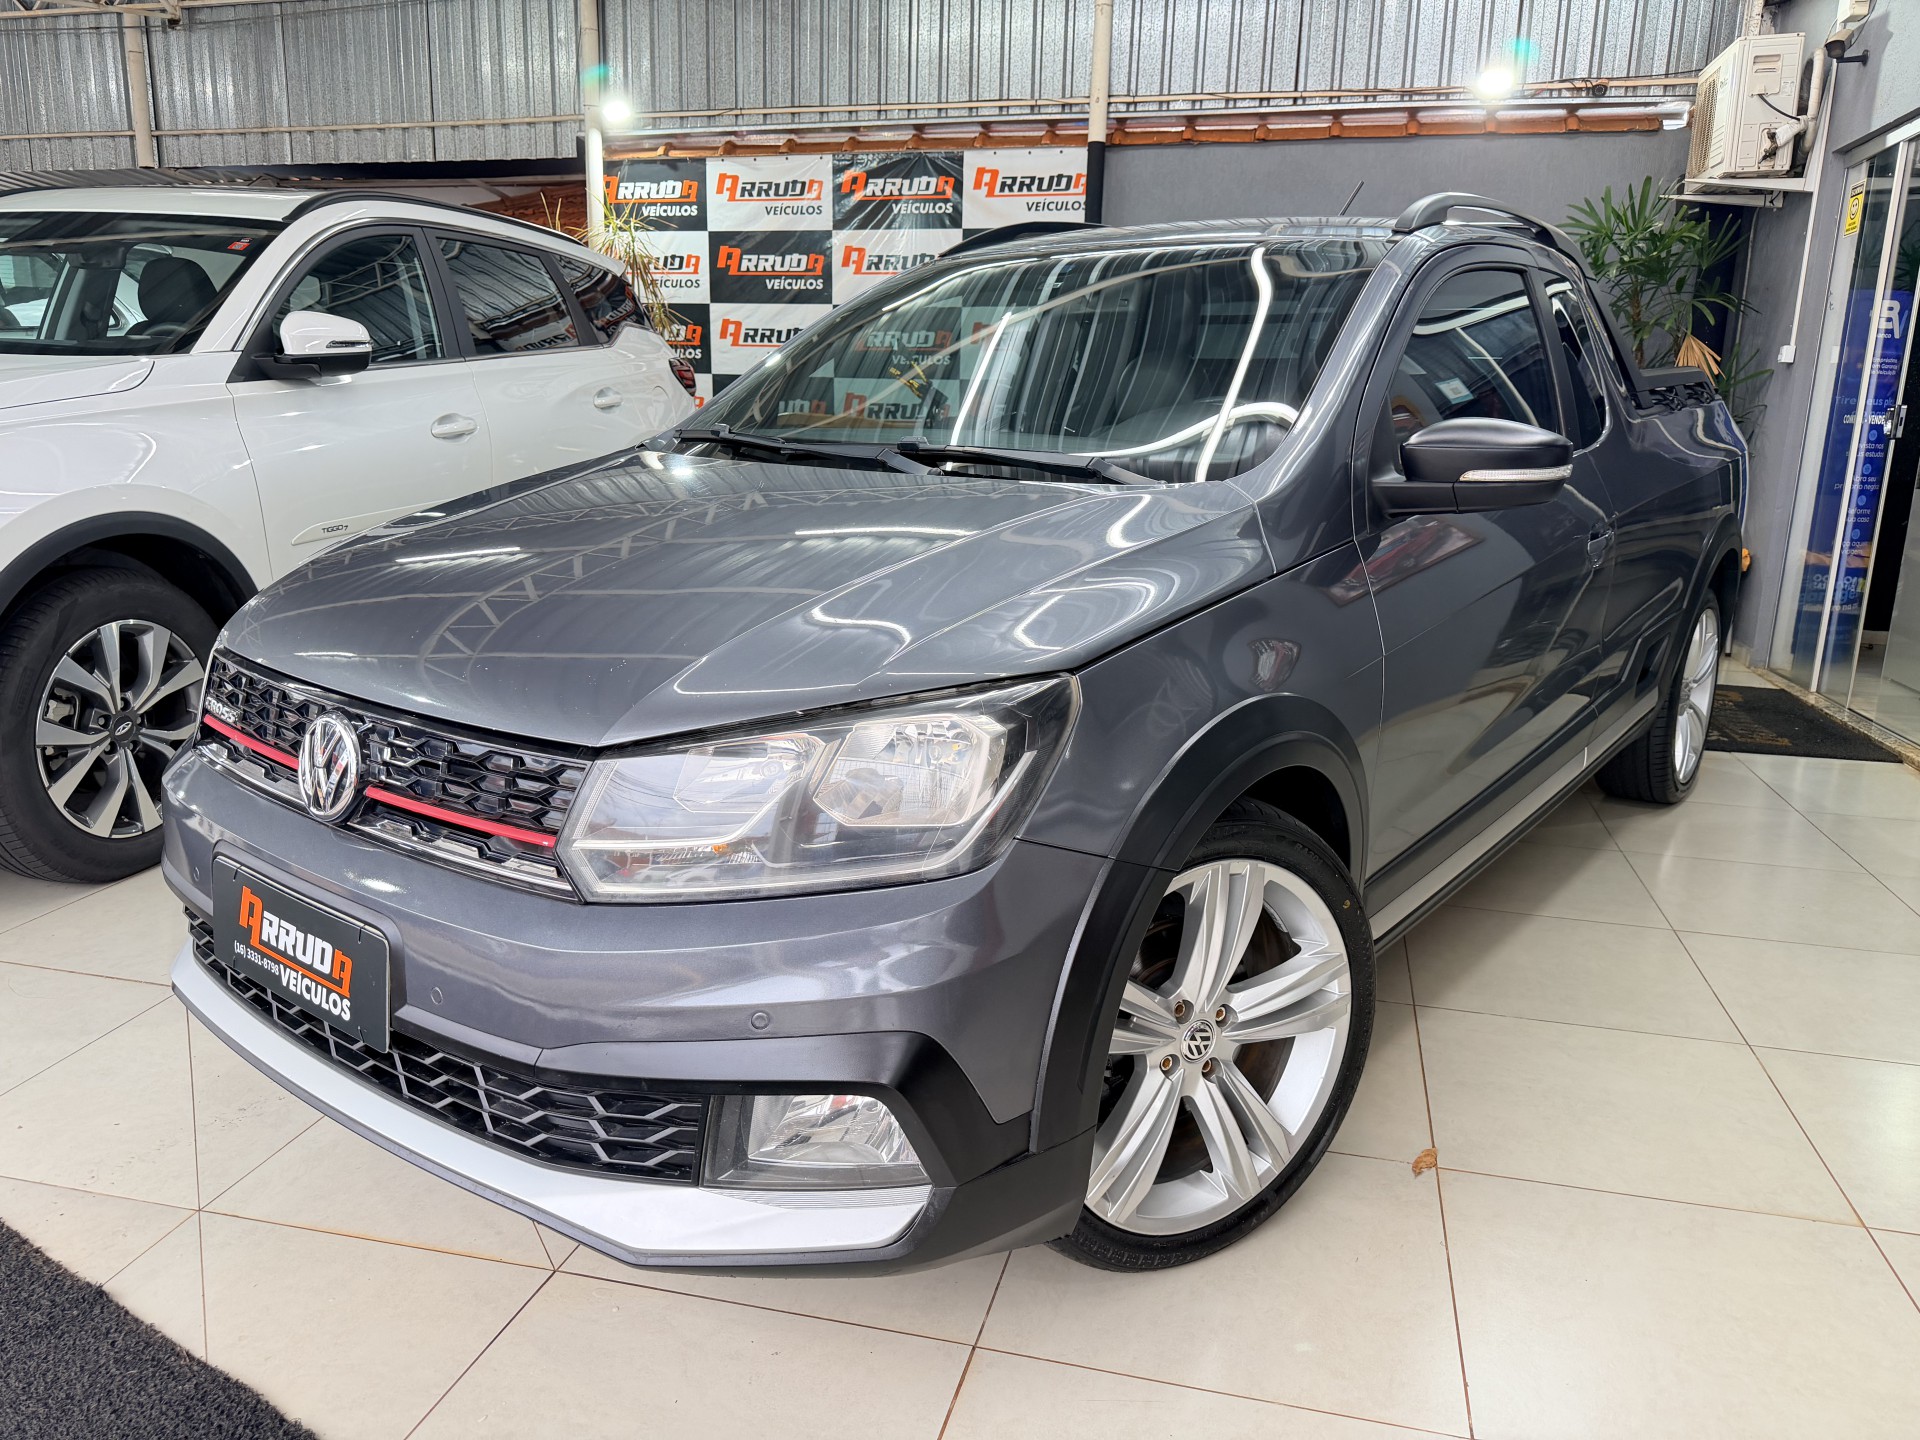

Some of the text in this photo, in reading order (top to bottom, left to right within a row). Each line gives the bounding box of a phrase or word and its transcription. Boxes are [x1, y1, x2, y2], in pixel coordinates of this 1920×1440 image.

[716, 172, 824, 203] ARRUDA
[840, 169, 955, 201] ARRUDA
[642, 203, 698, 217] VEÍCULOS
[765, 204, 823, 216] VEÍCULOS
[891, 201, 954, 214] VEÍCULOS
[717, 245, 825, 276] ARRUDA
[841, 245, 936, 276] ARRUD
[765, 276, 824, 290] VEÍCULOS
[719, 318, 804, 347] ARRU
[856, 330, 953, 352] RRUDA
[234, 940, 247, 959] (16)
[239, 885, 353, 999] ARRUDA
[279, 962, 352, 1022] VEÍCULOS
